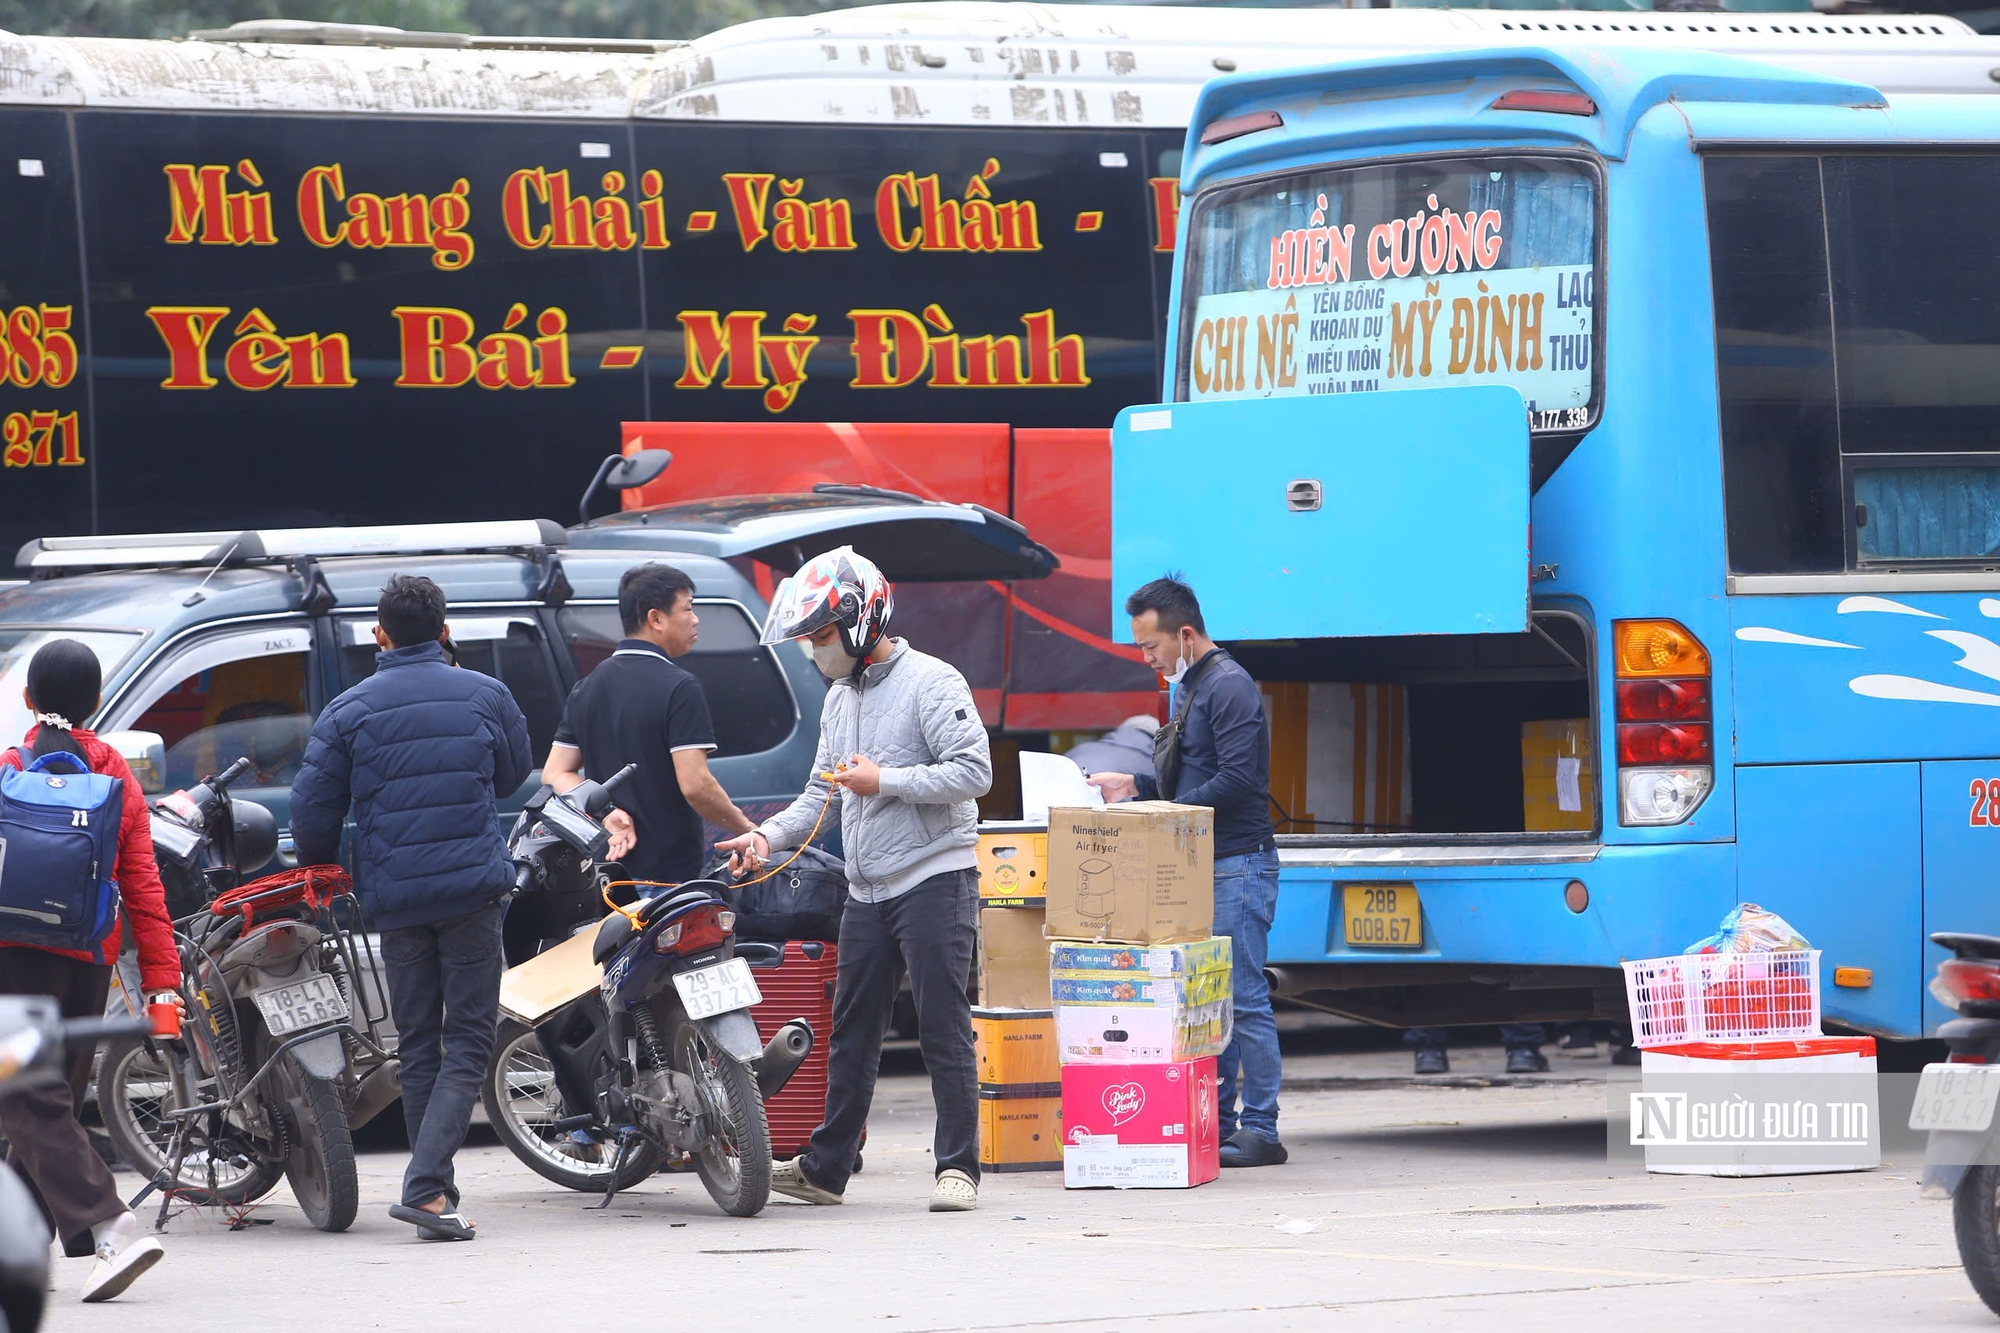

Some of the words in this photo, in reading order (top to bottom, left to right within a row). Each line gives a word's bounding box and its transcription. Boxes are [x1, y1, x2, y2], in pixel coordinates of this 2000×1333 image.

[165, 158, 278, 245] Mù
[297, 163, 474, 271] Cang
[502, 165, 670, 250] Chải
[721, 173, 857, 252] Văn
[875, 157, 1043, 252] Chấn
[1267, 193, 1355, 290] HIỀN
[1366, 193, 1503, 281] CƯỜNG
[1312, 288, 1340, 314] YÊN
[1343, 282, 1385, 312] BỒNG
[1193, 318, 1248, 394] CHI
[1257, 293, 1300, 390] NÊ
[1310, 317, 1359, 341] KHOAN
[1363, 316, 1383, 342] DỤ
[1387, 280, 1442, 379] MỸ
[1448, 279, 1545, 376] ĐÌNH
[0, 302, 78, 389] 85
[145, 306, 357, 390] Yên
[391, 302, 576, 390] Bái
[675, 310, 820, 413] Mỹ
[847, 304, 1092, 389] Đình
[1306, 344, 1343, 374] MIẾU
[1347, 344, 1381, 372] MÔN
[1549, 318, 1592, 371] THỦ
[1567, 406, 1588, 427] 339
[3, 410, 86, 468] 271
[263, 638, 295, 650] ZACE
[1075, 841, 1090, 851] Air
[1093, 842, 1118, 854] fryer
[1364, 889, 1396, 913] 28B
[1352, 917, 1411, 942] 008.67
[693, 955, 716, 965] HONDA
[685, 964, 740, 994] 29-AC
[270, 980, 325, 1011] 18-L1
[688, 982, 755, 1016] 337.21
[271, 998, 341, 1032] 015.63
[1112, 1015, 1119, 1024] B
[1109, 1087, 1137, 1106] Pink
[1934, 1070, 1988, 1096] 18-E1
[1113, 1099, 1140, 1115] Lady
